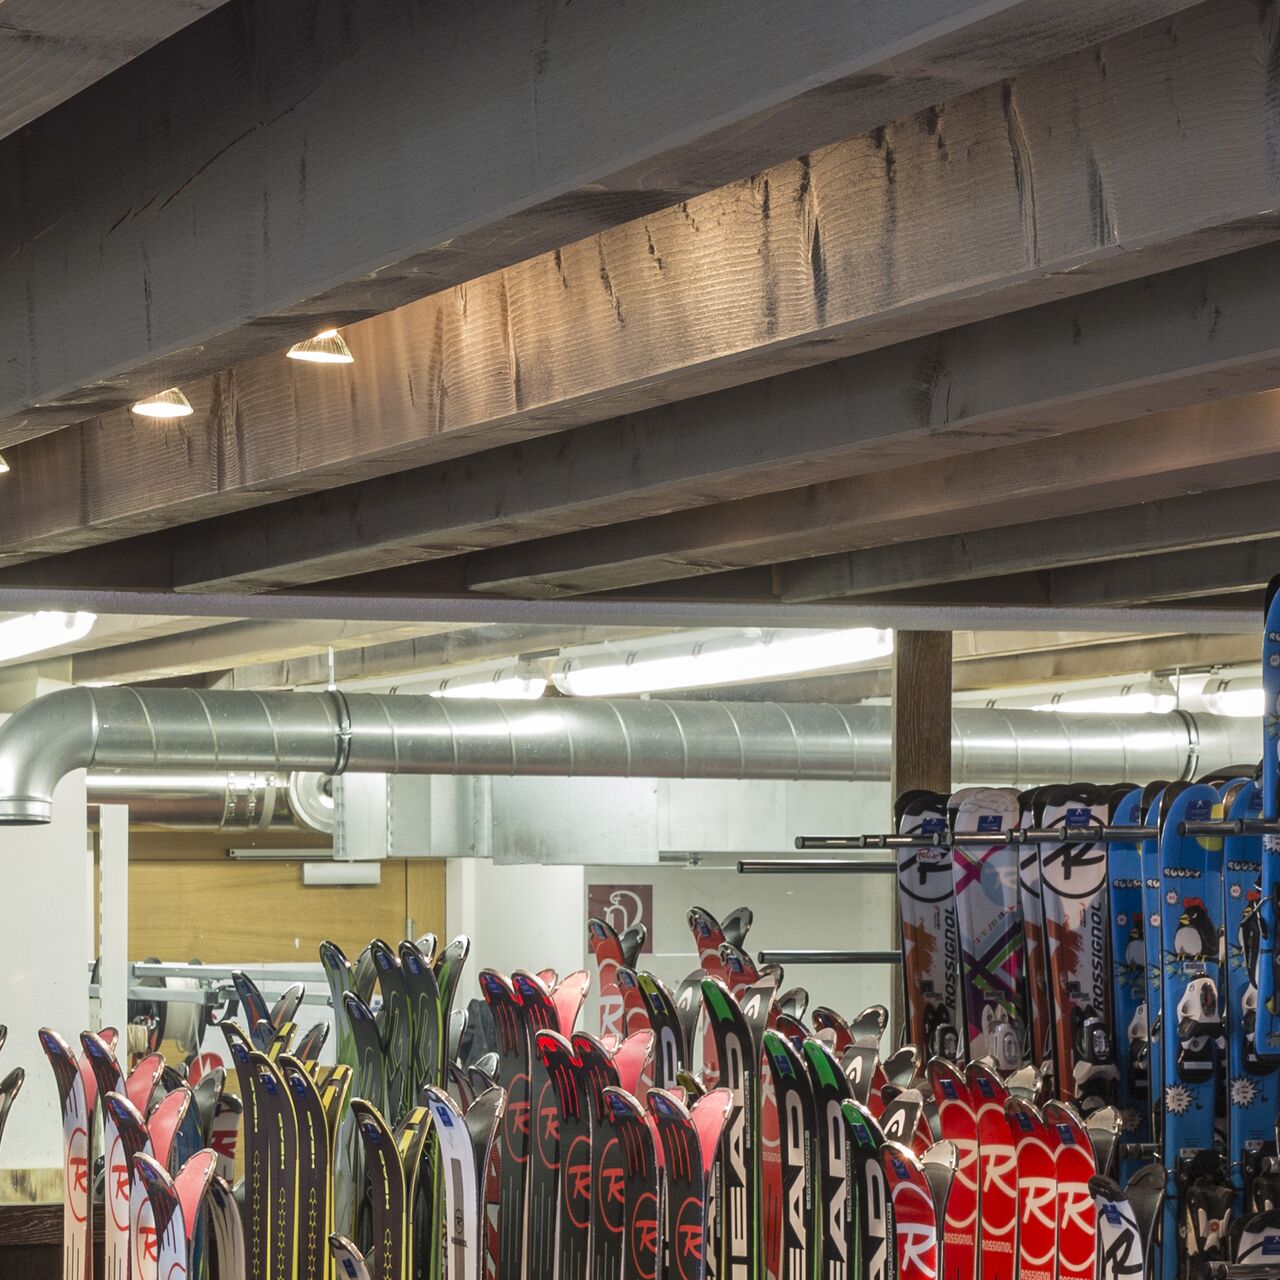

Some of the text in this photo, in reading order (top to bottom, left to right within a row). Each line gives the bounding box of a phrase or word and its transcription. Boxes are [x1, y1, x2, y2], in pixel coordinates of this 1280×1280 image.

[945, 905, 956, 1011] ROSSIGNOL
[1093, 901, 1103, 1018] ROSSIGNOL
[943, 1233, 974, 1246] ROSSIGNOL
[981, 1239, 1013, 1253] ROSSIGNOL
